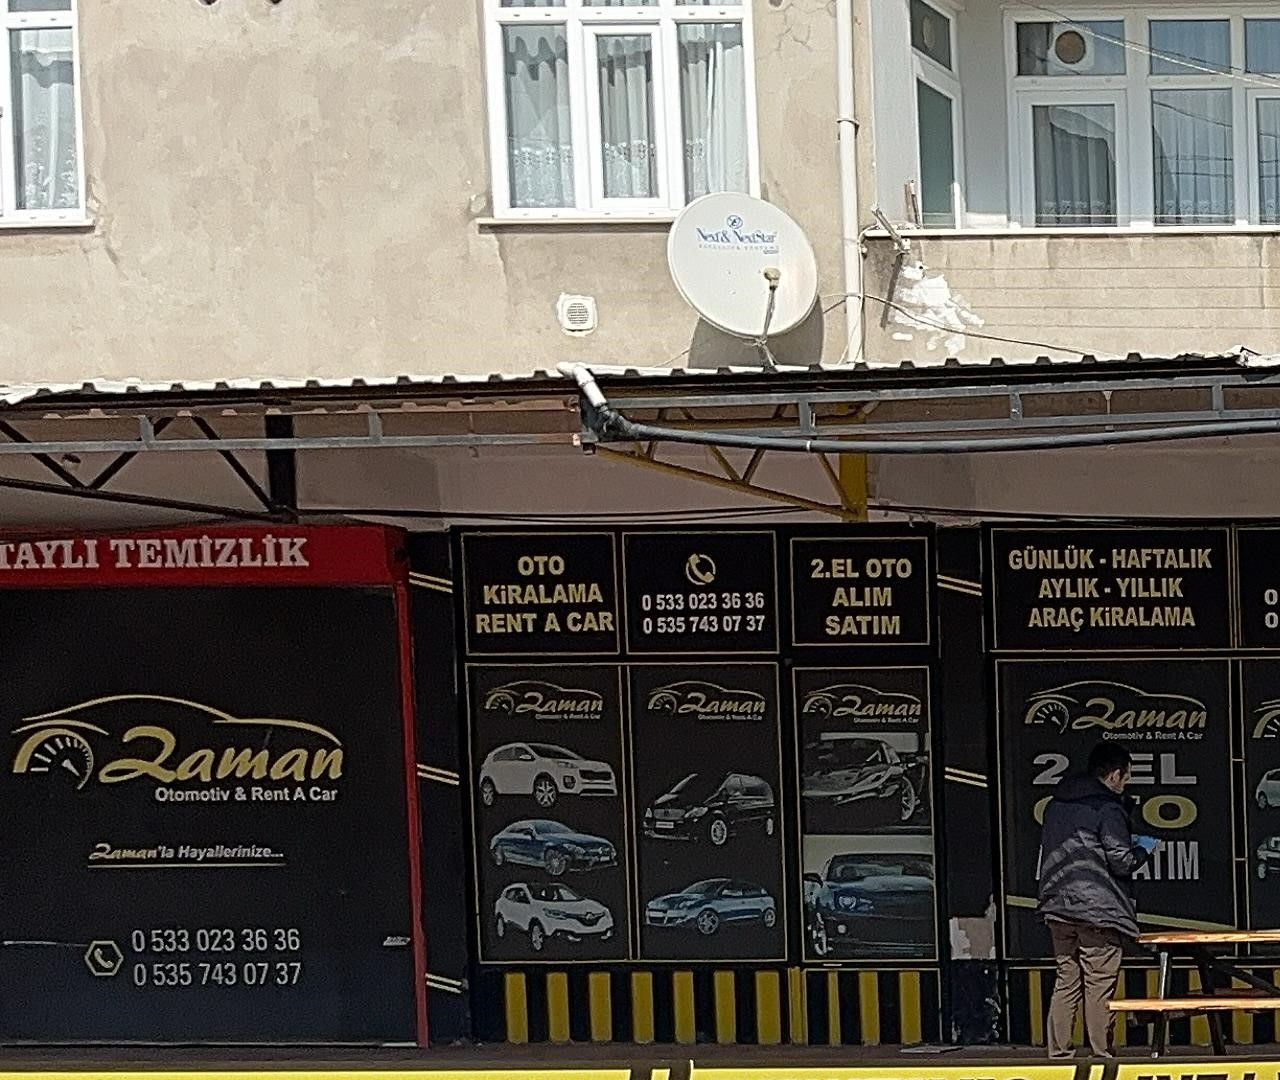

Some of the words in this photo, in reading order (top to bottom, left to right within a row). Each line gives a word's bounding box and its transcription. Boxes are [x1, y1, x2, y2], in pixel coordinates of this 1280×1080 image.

[110, 533, 310, 569] TEMİZLİK
[1008, 545, 1095, 570] GÜNLÜK
[1112, 548, 1213, 569] HAFTALIK
[517, 555, 565, 576] OTO
[810, 558, 860, 579] 2.EL
[866, 558, 912, 579] OTO
[832, 586, 892, 607] ALIM
[1038, 577, 1099, 598] AYLIK
[1115, 577, 1184, 598] YILLIK
[1264, 588, 1279, 605] 0
[642, 594, 652, 612] 0
[656, 593, 685, 611] 533
[688, 592, 717, 610] 023
[722, 591, 741, 609] 36
[745, 591, 765, 609] 36
[475, 612, 537, 634] RENT
[544, 612, 561, 633] A
[566, 611, 615, 633] CAR
[643, 616, 653, 635] 0
[657, 615, 686, 634] 535
[689, 614, 719, 633] 743
[722, 613, 742, 633] 07
[746, 613, 765, 632] 37
[825, 615, 901, 636] SATIM
[1028, 606, 1084, 632] ARAÇ
[1264, 611, 1279, 628] 0
[1071, 697, 1207, 730] Zaman
[1178, 730, 1186, 740] A
[1187, 730, 1204, 740] Car
[98, 726, 344, 783] Zaman
[155, 786, 230, 801] Otomotiv
[234, 786, 247, 801] &
[251, 786, 290, 801] Rent
[293, 786, 306, 801] A
[309, 786, 338, 802] Car
[131, 929, 146, 952] 0
[150, 929, 190, 952] 533
[196, 929, 236, 952] 023
[240, 928, 269, 951] 36
[273, 928, 301, 951] 36
[133, 963, 147, 986] 0
[152, 963, 193, 986] 535
[199, 963, 237, 986] 743
[243, 962, 269, 985] 07
[275, 962, 302, 986] 37
